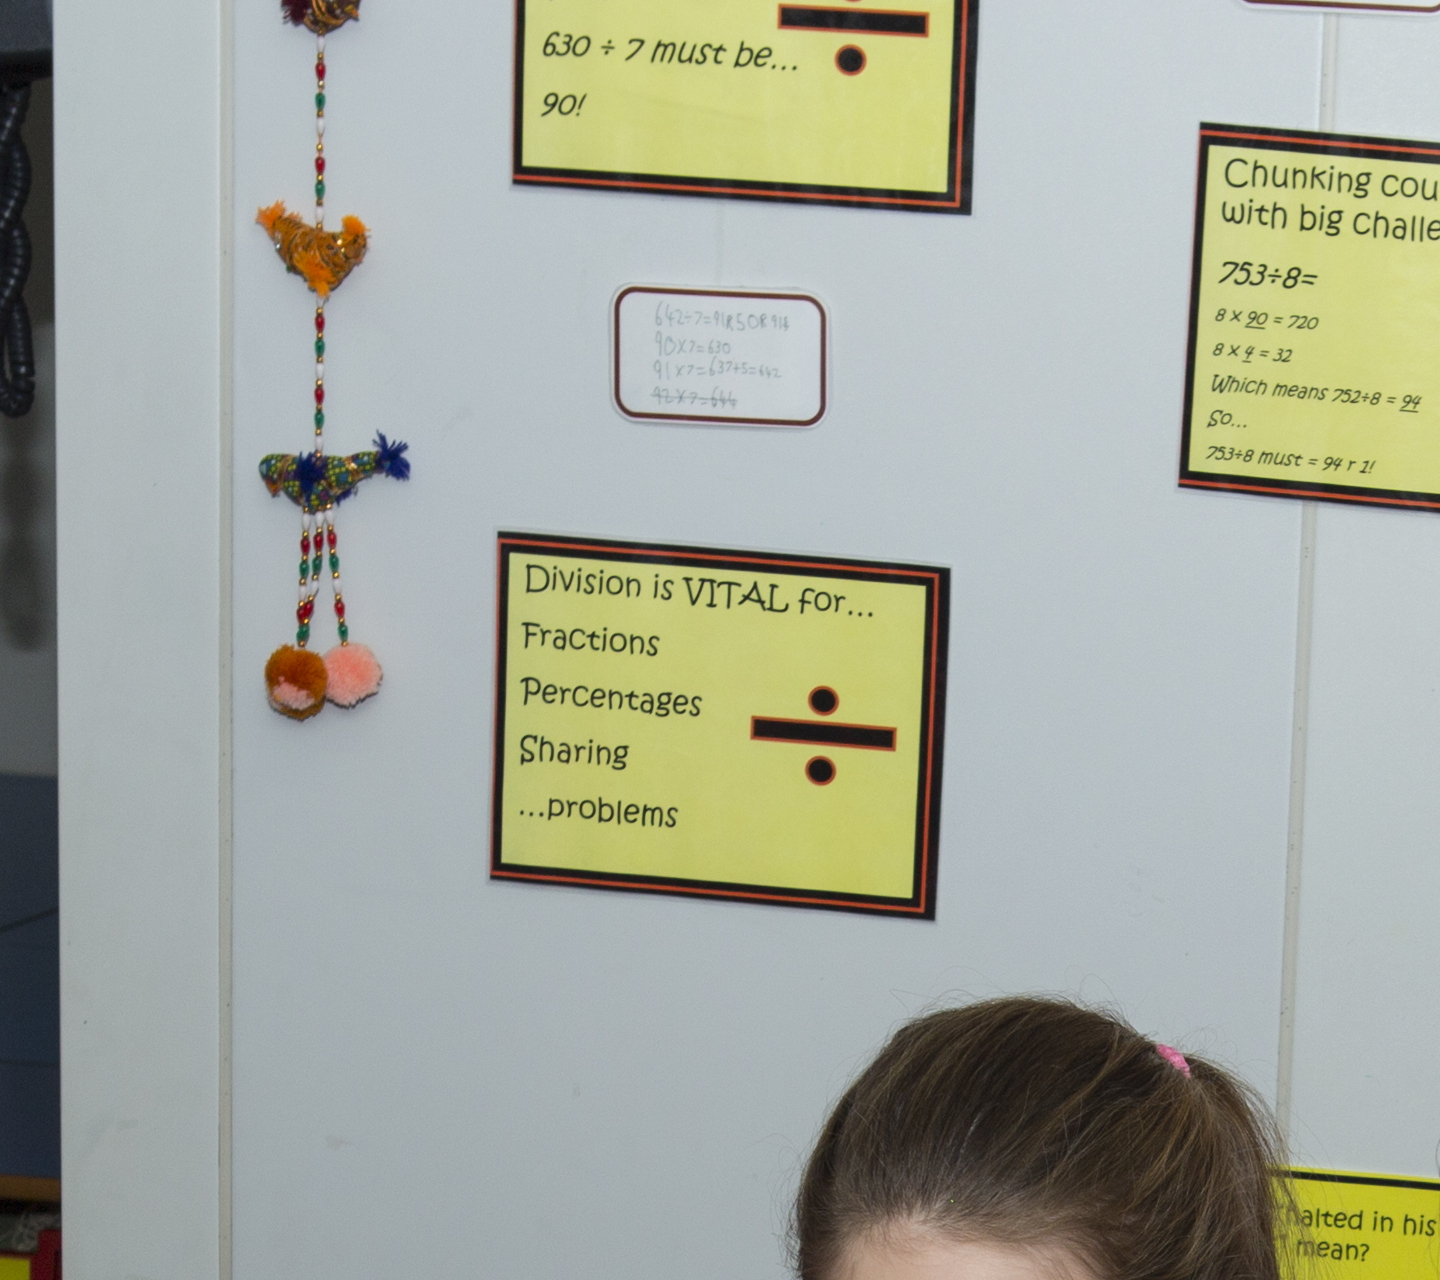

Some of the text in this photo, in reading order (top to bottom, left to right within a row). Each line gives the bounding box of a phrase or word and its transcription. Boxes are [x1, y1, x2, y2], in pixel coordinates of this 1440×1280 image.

[542, 31, 797, 71] 630 7 must be...
[541, 92, 587, 117] 90!
[1224, 158, 1372, 199] Chunking
[1221, 198, 1288, 229] with
[1299, 203, 1344, 237] big
[1287, 314, 1320, 330] 720
[1211, 373, 1268, 395] Which
[1271, 383, 1329, 401] means
[1399, 394, 1422, 414] 94
[1206, 409, 1247, 428] So...
[1257, 451, 1304, 467] must
[1322, 456, 1343, 472] 94
[525, 563, 873, 618] Division is VITAL for...
[521, 621, 660, 657] Fractions
[520, 676, 703, 718] Percentages
[519, 734, 630, 771] Sharing
[519, 796, 679, 828] ...problems
[1372, 1210, 1437, 1237] in his
[1296, 1238, 1370, 1262] mean?
